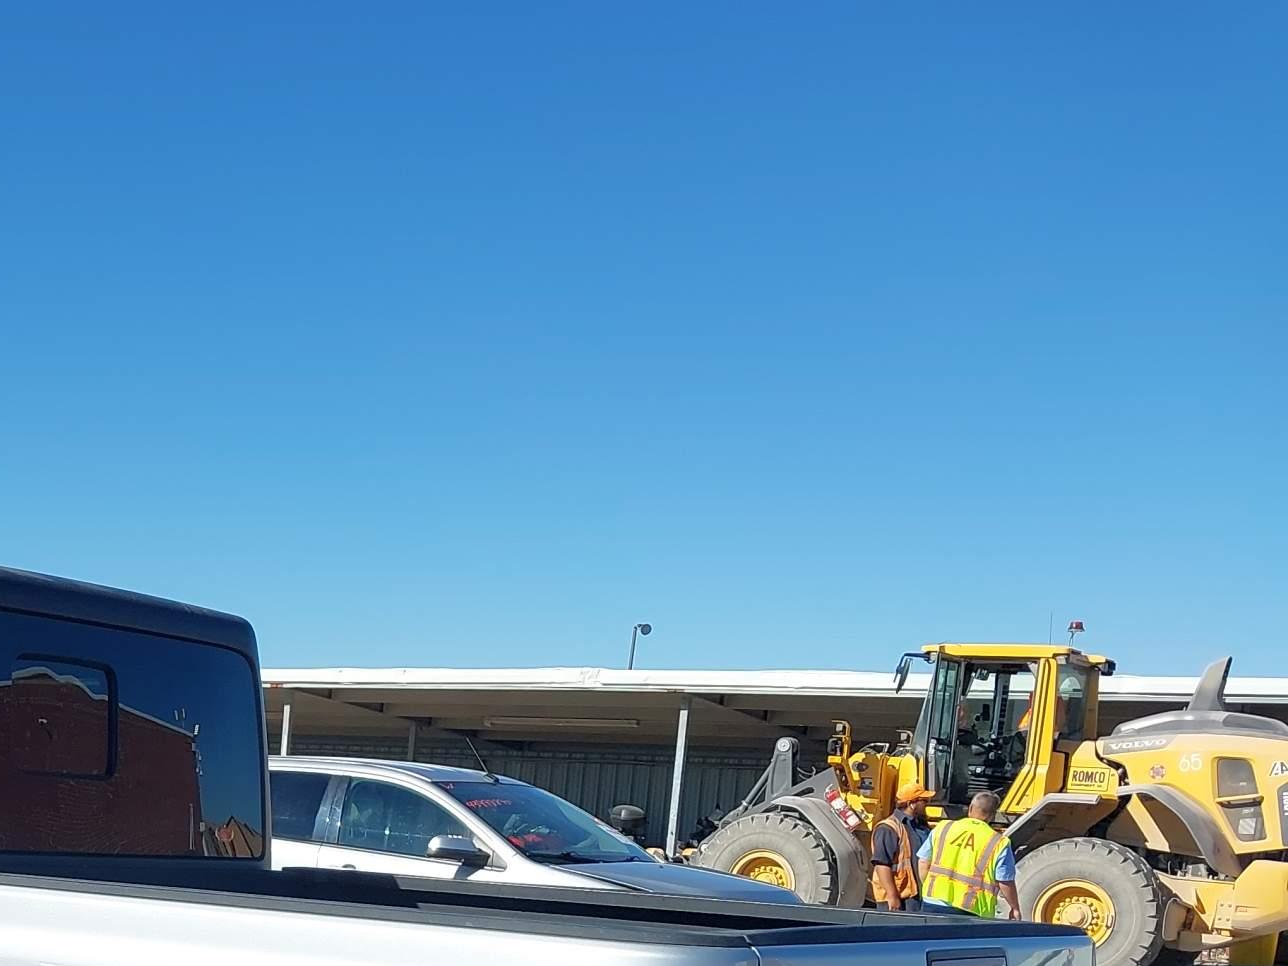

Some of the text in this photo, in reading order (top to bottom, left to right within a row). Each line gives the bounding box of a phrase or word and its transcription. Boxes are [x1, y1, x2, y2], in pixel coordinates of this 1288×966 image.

[1110, 738, 1167, 750] VOLVO
[1179, 753, 1202, 772] 65
[1072, 769, 1106, 783] ROMCO
